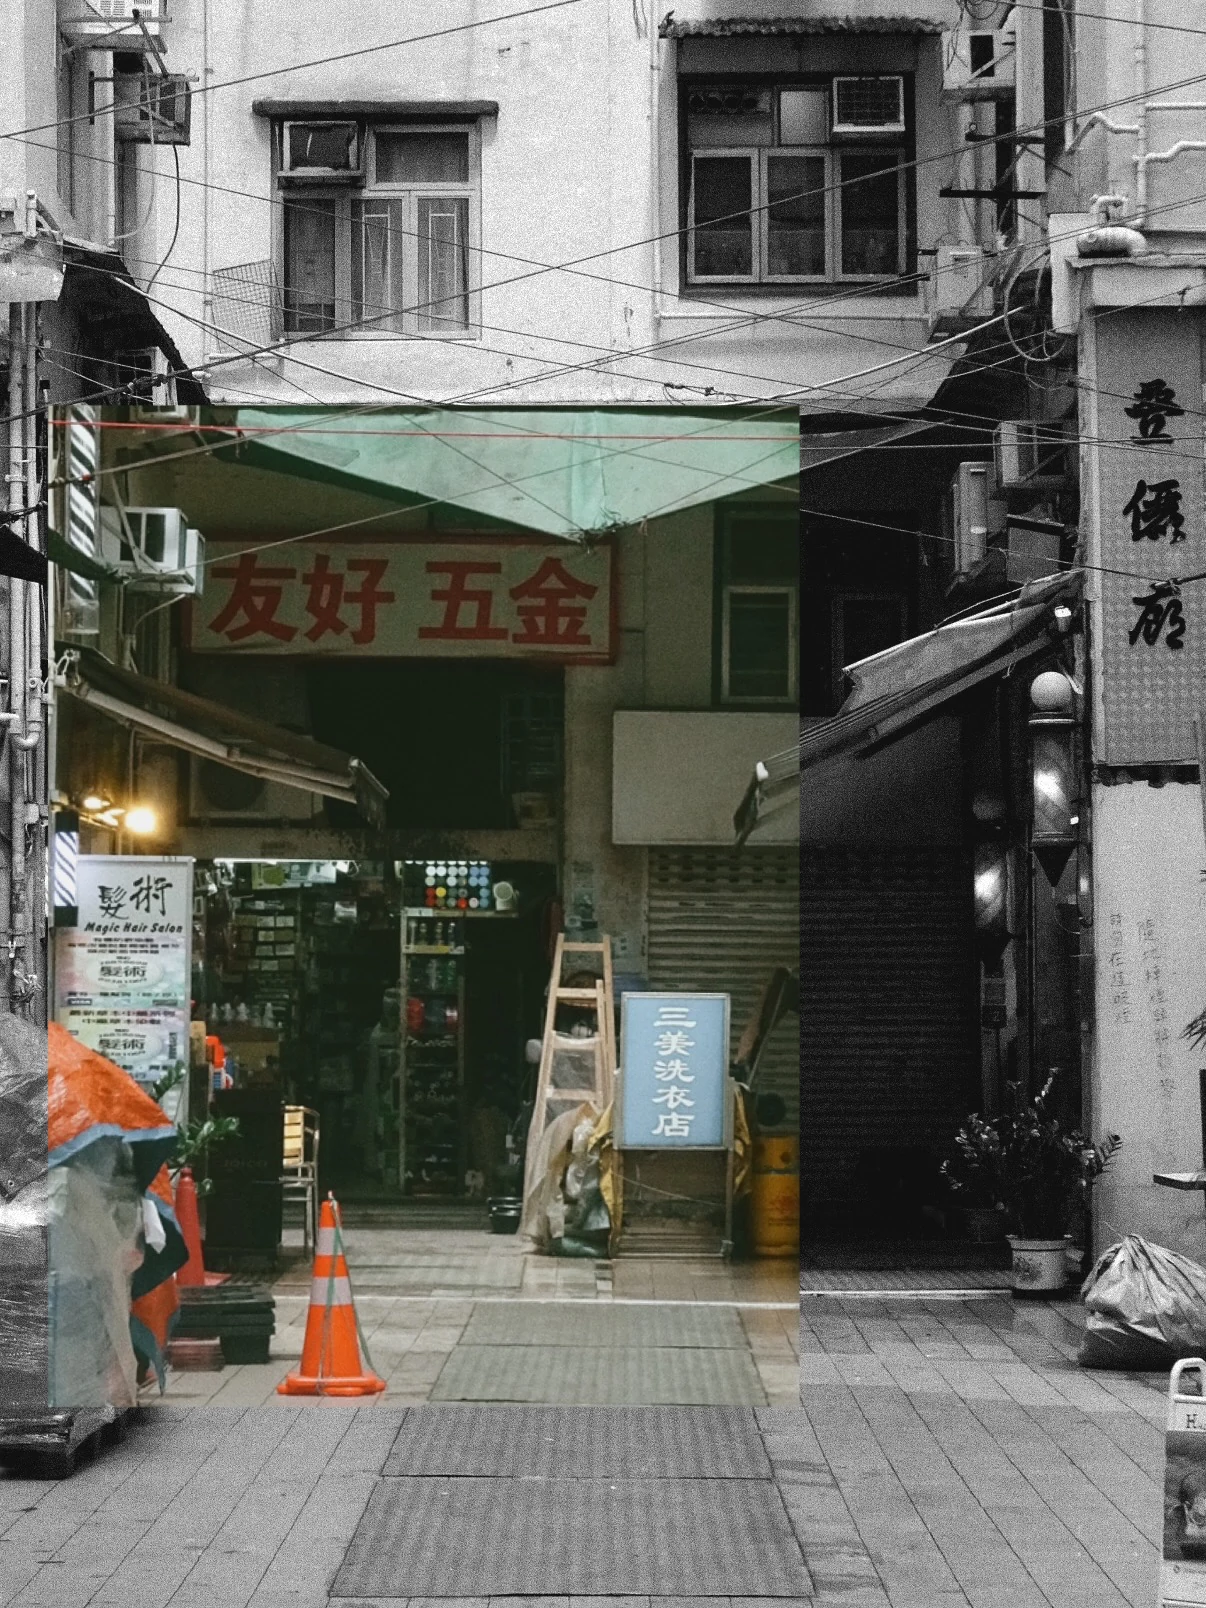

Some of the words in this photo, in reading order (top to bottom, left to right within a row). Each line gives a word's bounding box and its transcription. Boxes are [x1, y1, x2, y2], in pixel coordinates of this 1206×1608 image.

[208, 553, 599, 646] 友好五金
[83, 921, 121, 936] Magic
[122, 921, 149, 933] Hair
[150, 922, 184, 934] Salon
[97, 873, 174, 920] 髮術
[652, 1006, 697, 1138] 三美洗衣店
